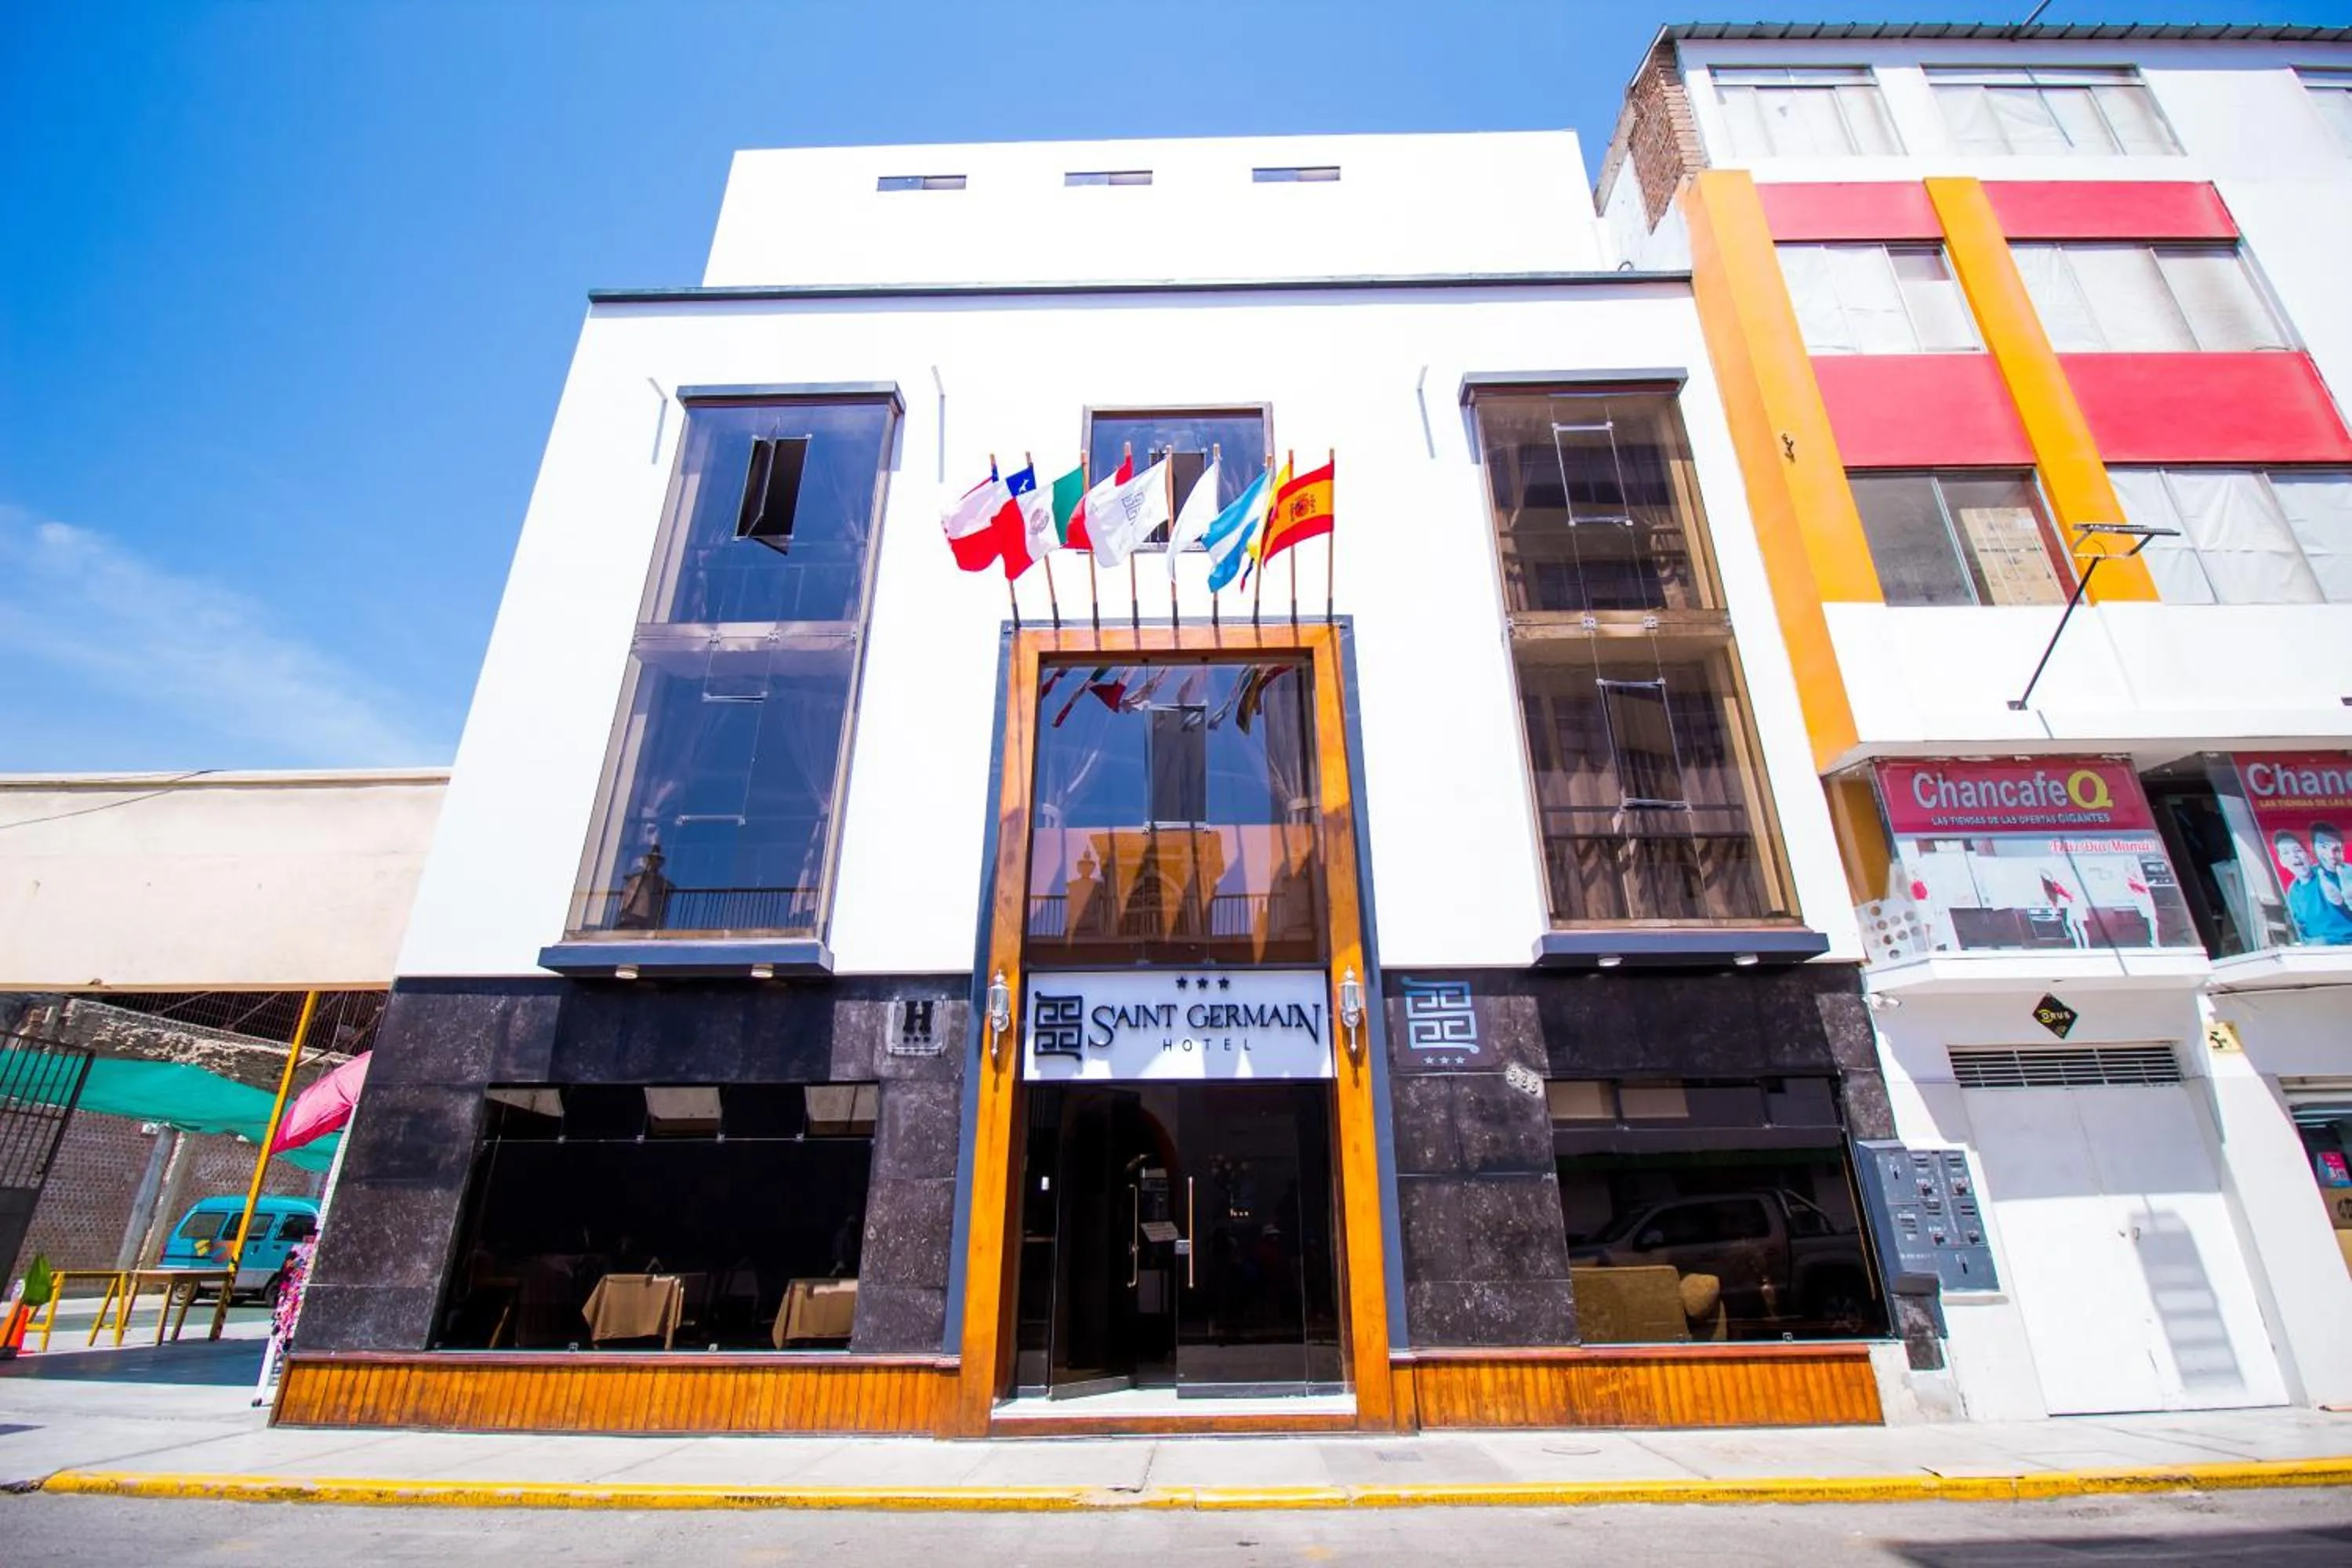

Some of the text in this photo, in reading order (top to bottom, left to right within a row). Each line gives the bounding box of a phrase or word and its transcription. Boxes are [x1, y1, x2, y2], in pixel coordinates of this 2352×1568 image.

[2057, 812, 2111, 823] GIGANTES
[1087, 1003, 1321, 1047] SAINT GERMAIN
[1163, 1037, 1251, 1051] HOTEL
